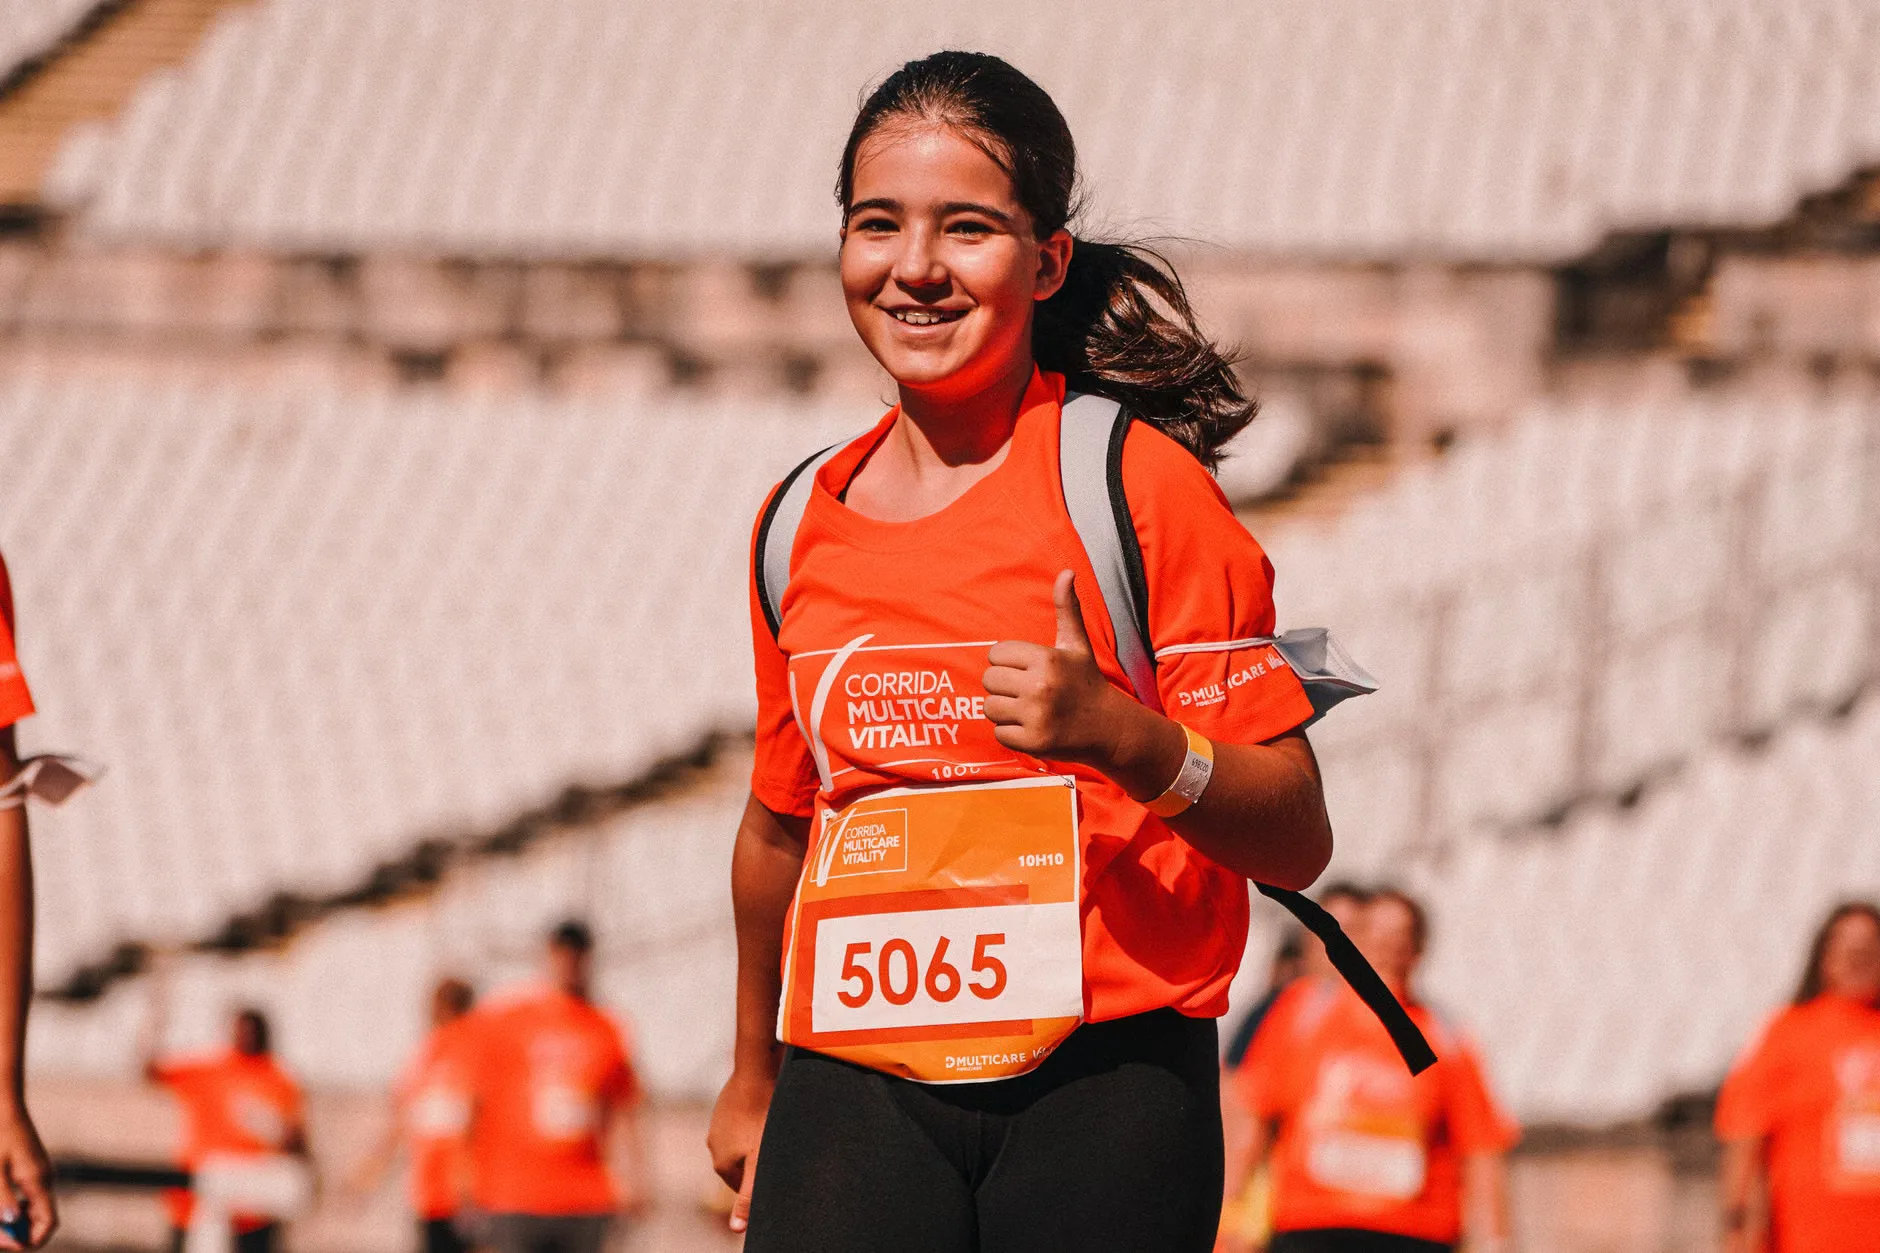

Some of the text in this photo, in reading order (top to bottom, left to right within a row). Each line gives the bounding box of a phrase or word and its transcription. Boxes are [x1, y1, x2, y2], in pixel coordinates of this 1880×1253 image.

[845, 670, 954, 697] CORRIDA
[1191, 662, 1267, 701] MULICARE
[847, 696, 986, 724] MULTICARE
[848, 723, 959, 749] VITALITY
[845, 824, 887, 840] CORRIDA
[843, 835, 900, 853] MULTICARE
[842, 849, 887, 865] VITALITY
[1018, 853, 1064, 868] 10H10
[837, 933, 1008, 1009] 5065
[956, 1052, 1026, 1067] MULTICARE
